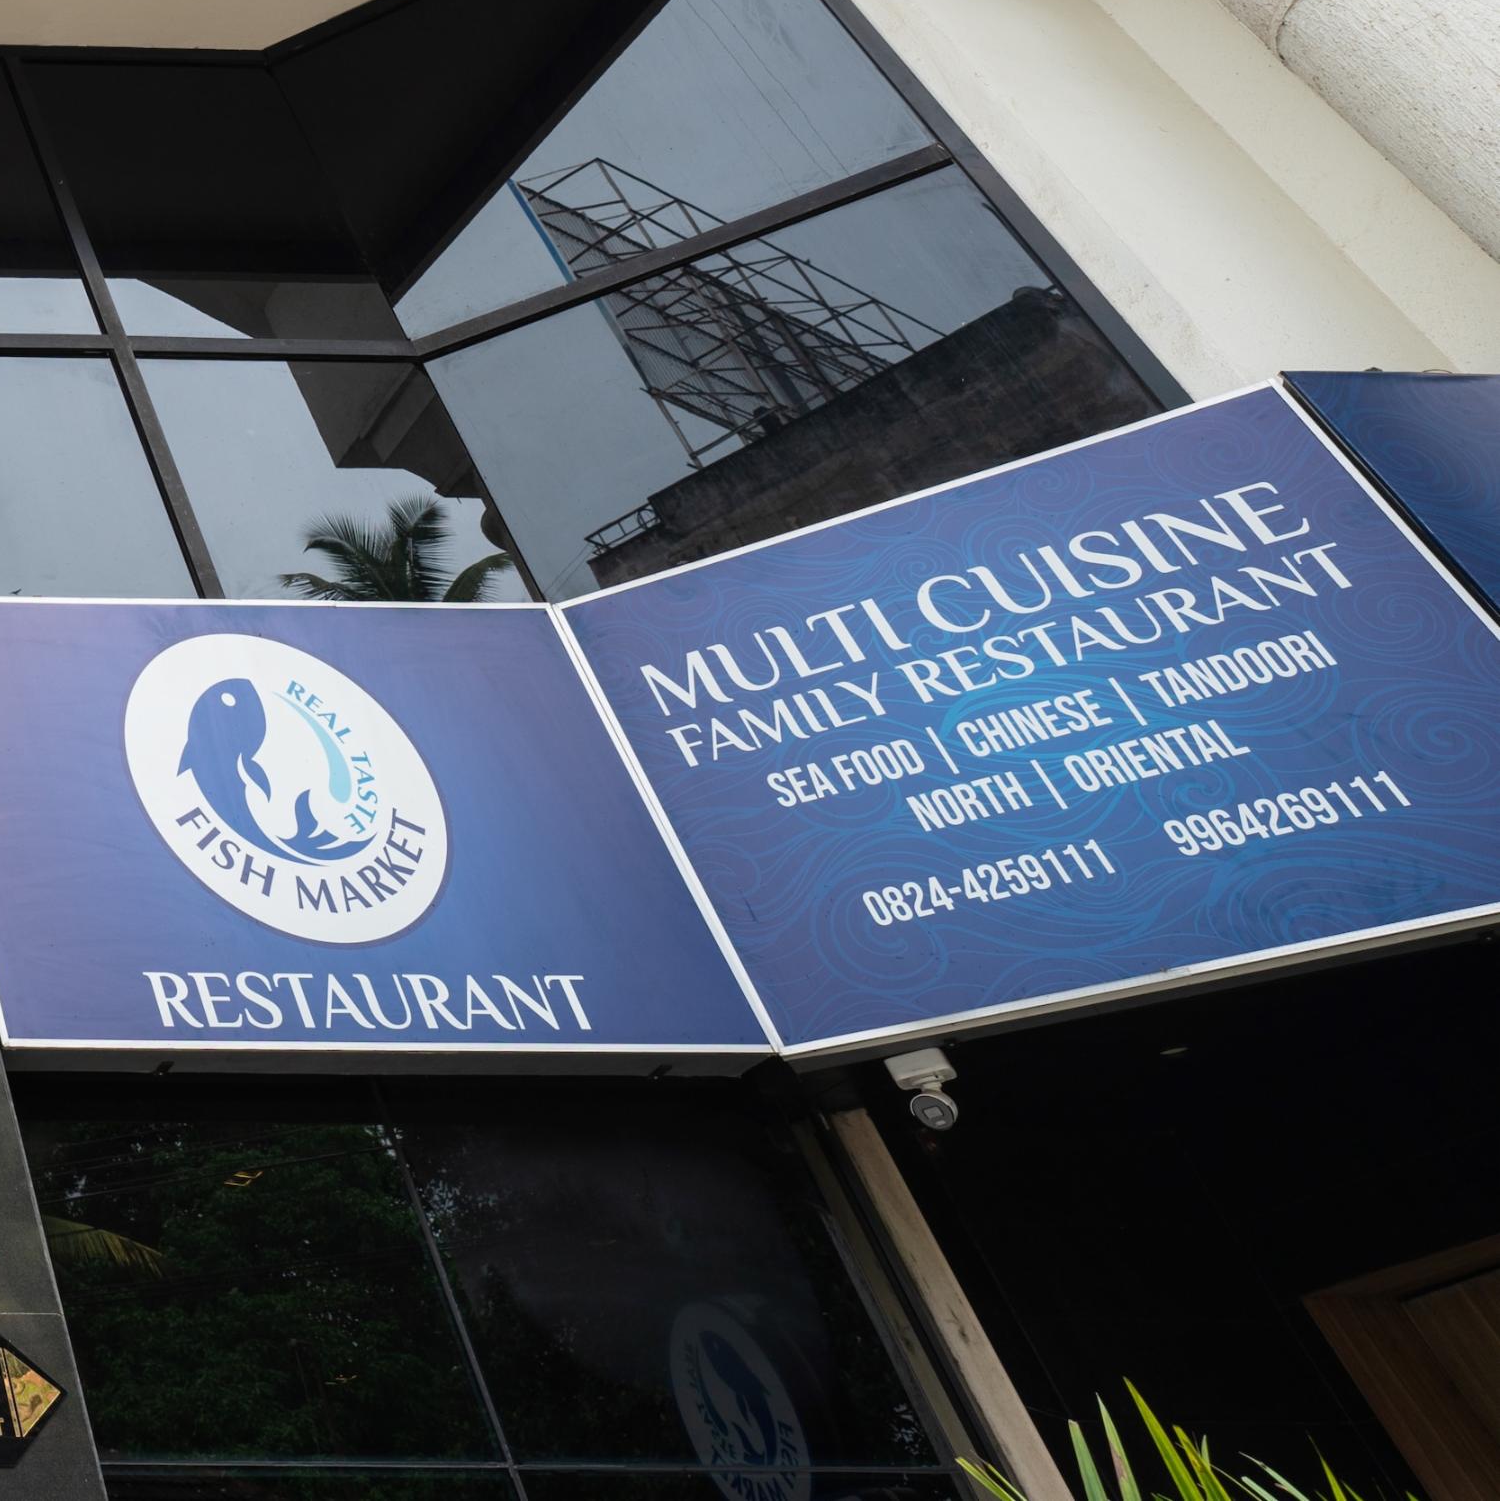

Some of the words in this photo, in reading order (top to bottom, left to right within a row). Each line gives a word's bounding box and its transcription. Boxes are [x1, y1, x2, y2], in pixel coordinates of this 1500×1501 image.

[639, 597, 910, 717] MULTI
[916, 480, 1312, 635] CUISINE
[664, 676, 890, 768] FAMILY
[895, 541, 1353, 705] RESTAURANT
[286, 679, 351, 745] REAL
[343, 750, 379, 836] TASTE
[766, 757, 842, 809] SEA
[839, 737, 926, 793] FOOD
[956, 688, 1114, 759] CHINESE
[1138, 629, 1337, 707] TANDOORI
[905, 771, 1034, 834] NORTH
[1062, 719, 1251, 793] ORIENTAL
[175, 806, 275, 897] FISH
[295, 808, 427, 914] MARKET
[861, 838, 1117, 927] 0824-4259111
[1163, 770, 1412, 857] 9964269111
[142, 971, 592, 1031] RESTAURANT
